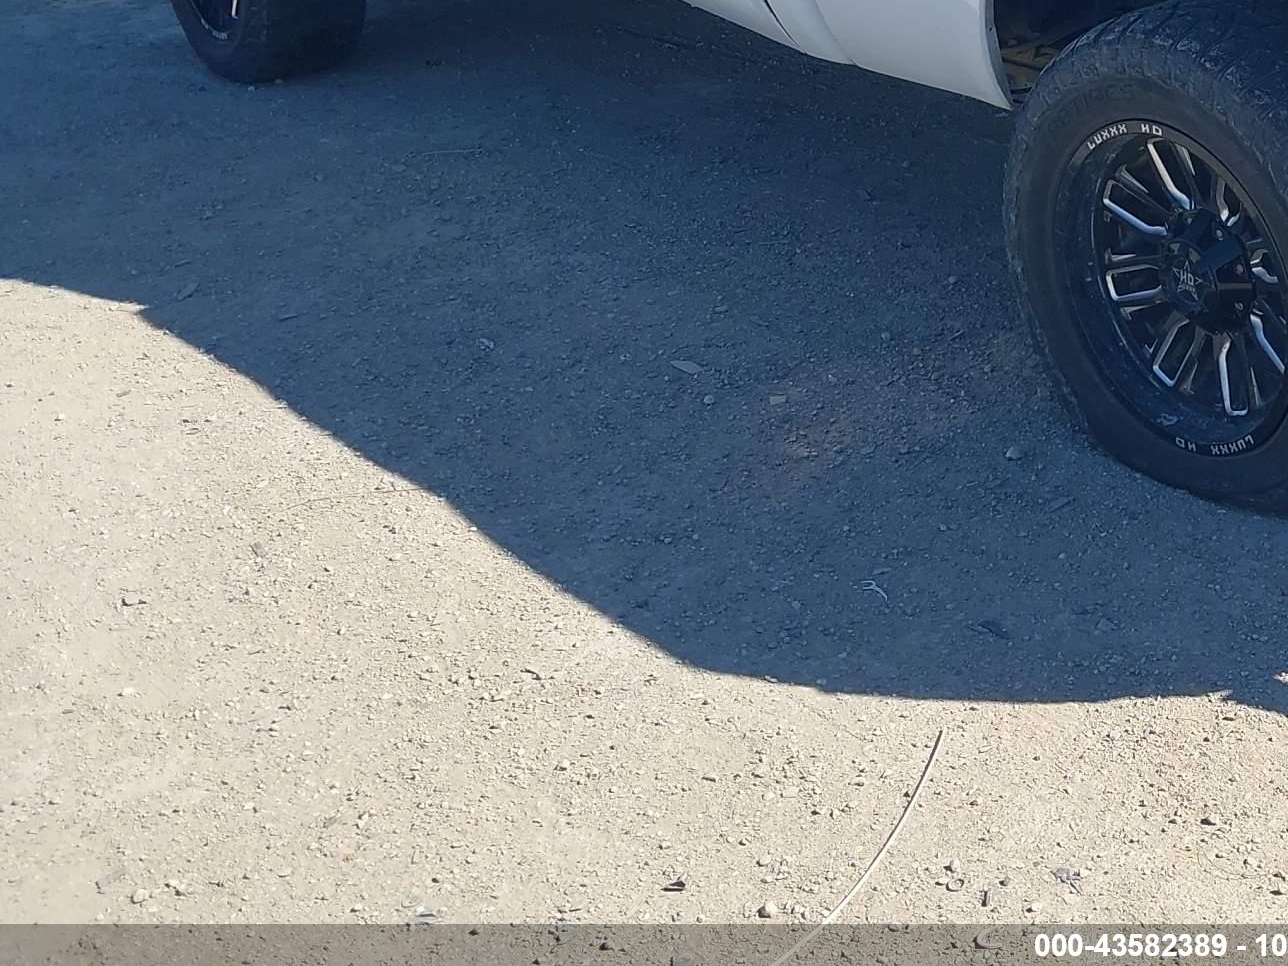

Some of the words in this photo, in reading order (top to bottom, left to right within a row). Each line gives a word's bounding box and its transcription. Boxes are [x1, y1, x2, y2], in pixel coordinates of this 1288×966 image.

[1086, 123, 1128, 151] LUXXX
[1141, 123, 1163, 137] HD
[1175, 436, 1197, 452] HD
[1210, 434, 1255, 455] LUXXX
